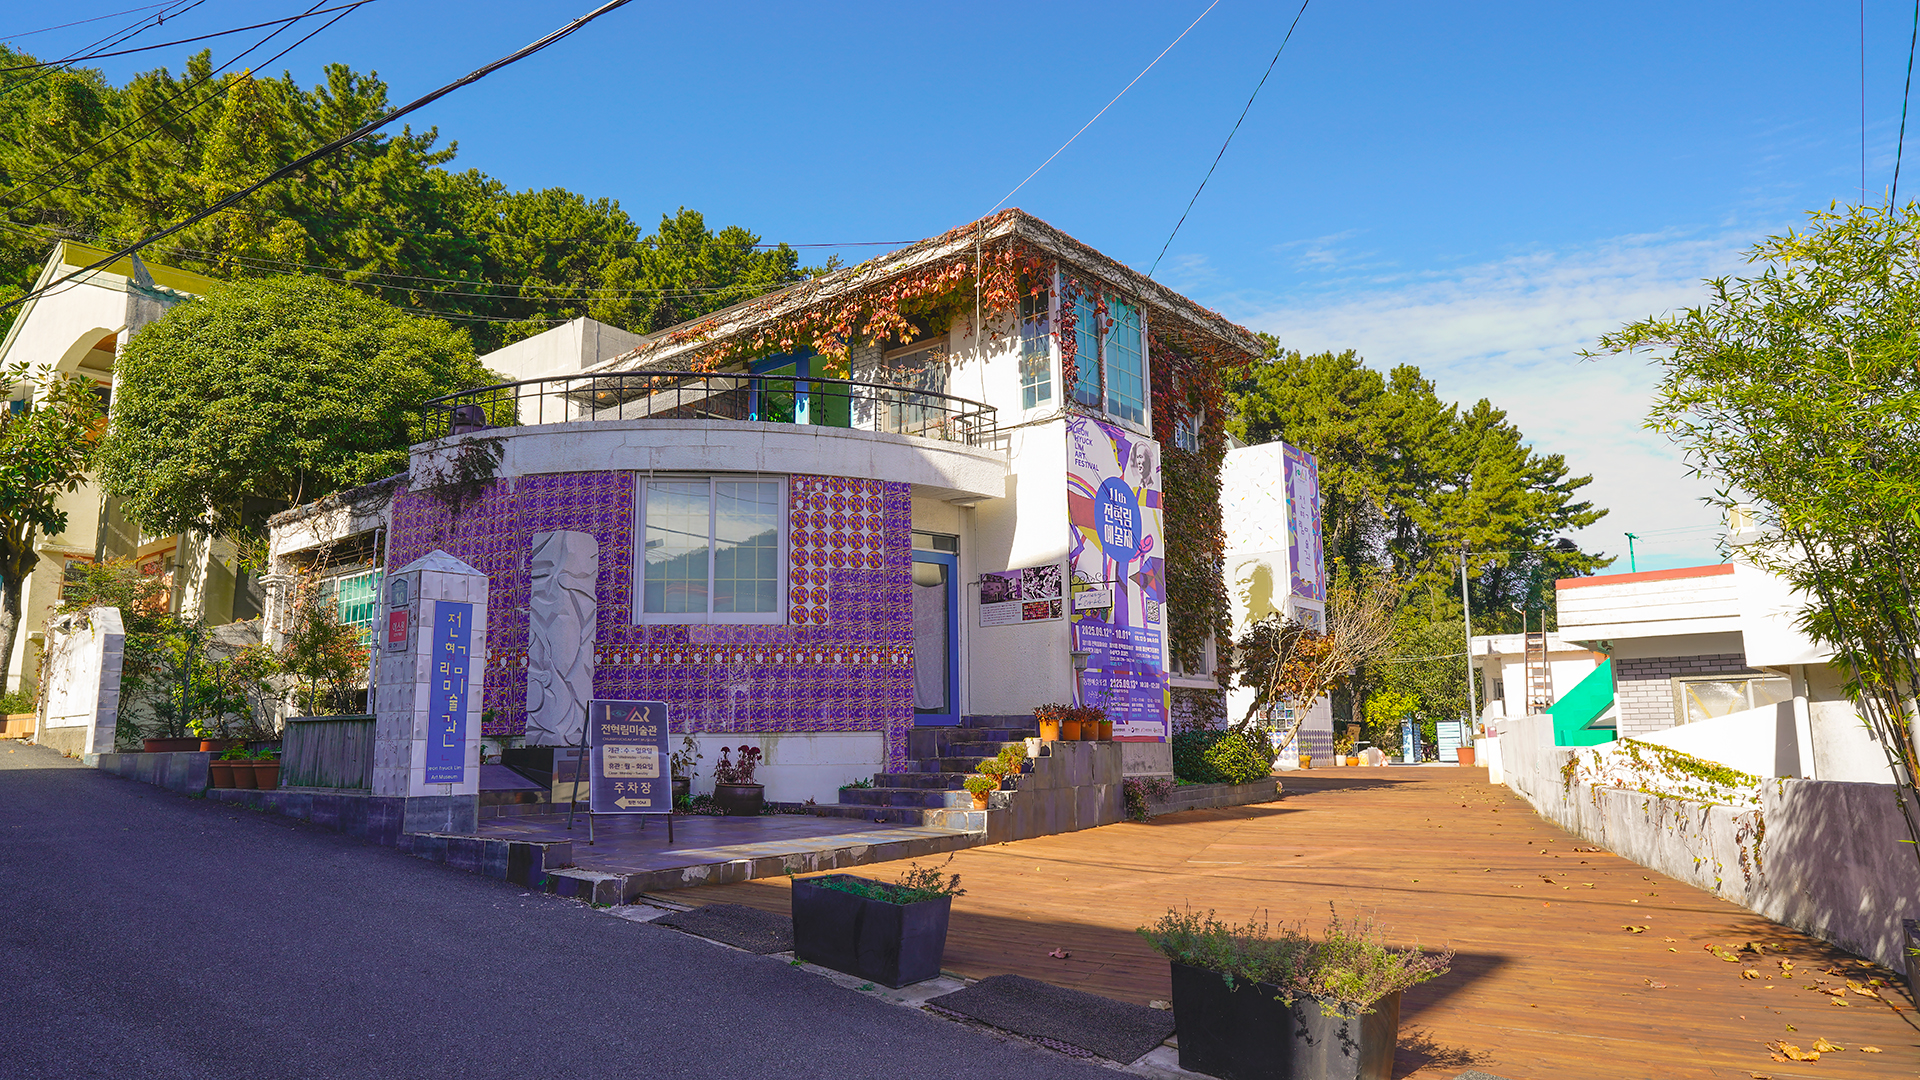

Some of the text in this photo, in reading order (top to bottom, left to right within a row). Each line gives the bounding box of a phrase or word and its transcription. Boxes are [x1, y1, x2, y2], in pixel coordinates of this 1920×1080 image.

[1074, 435, 1094, 446] HYUCK
[1074, 443, 1084, 452] LIM
[1074, 450, 1086, 460] ART
[1074, 459, 1100, 472] FESTIVAL
[1110, 488, 1127, 504] 11th
[1103, 502, 1132, 528] 전혁림
[1104, 524, 1134, 549] 예술제
[601, 724, 658, 736] 전혁림미술관
